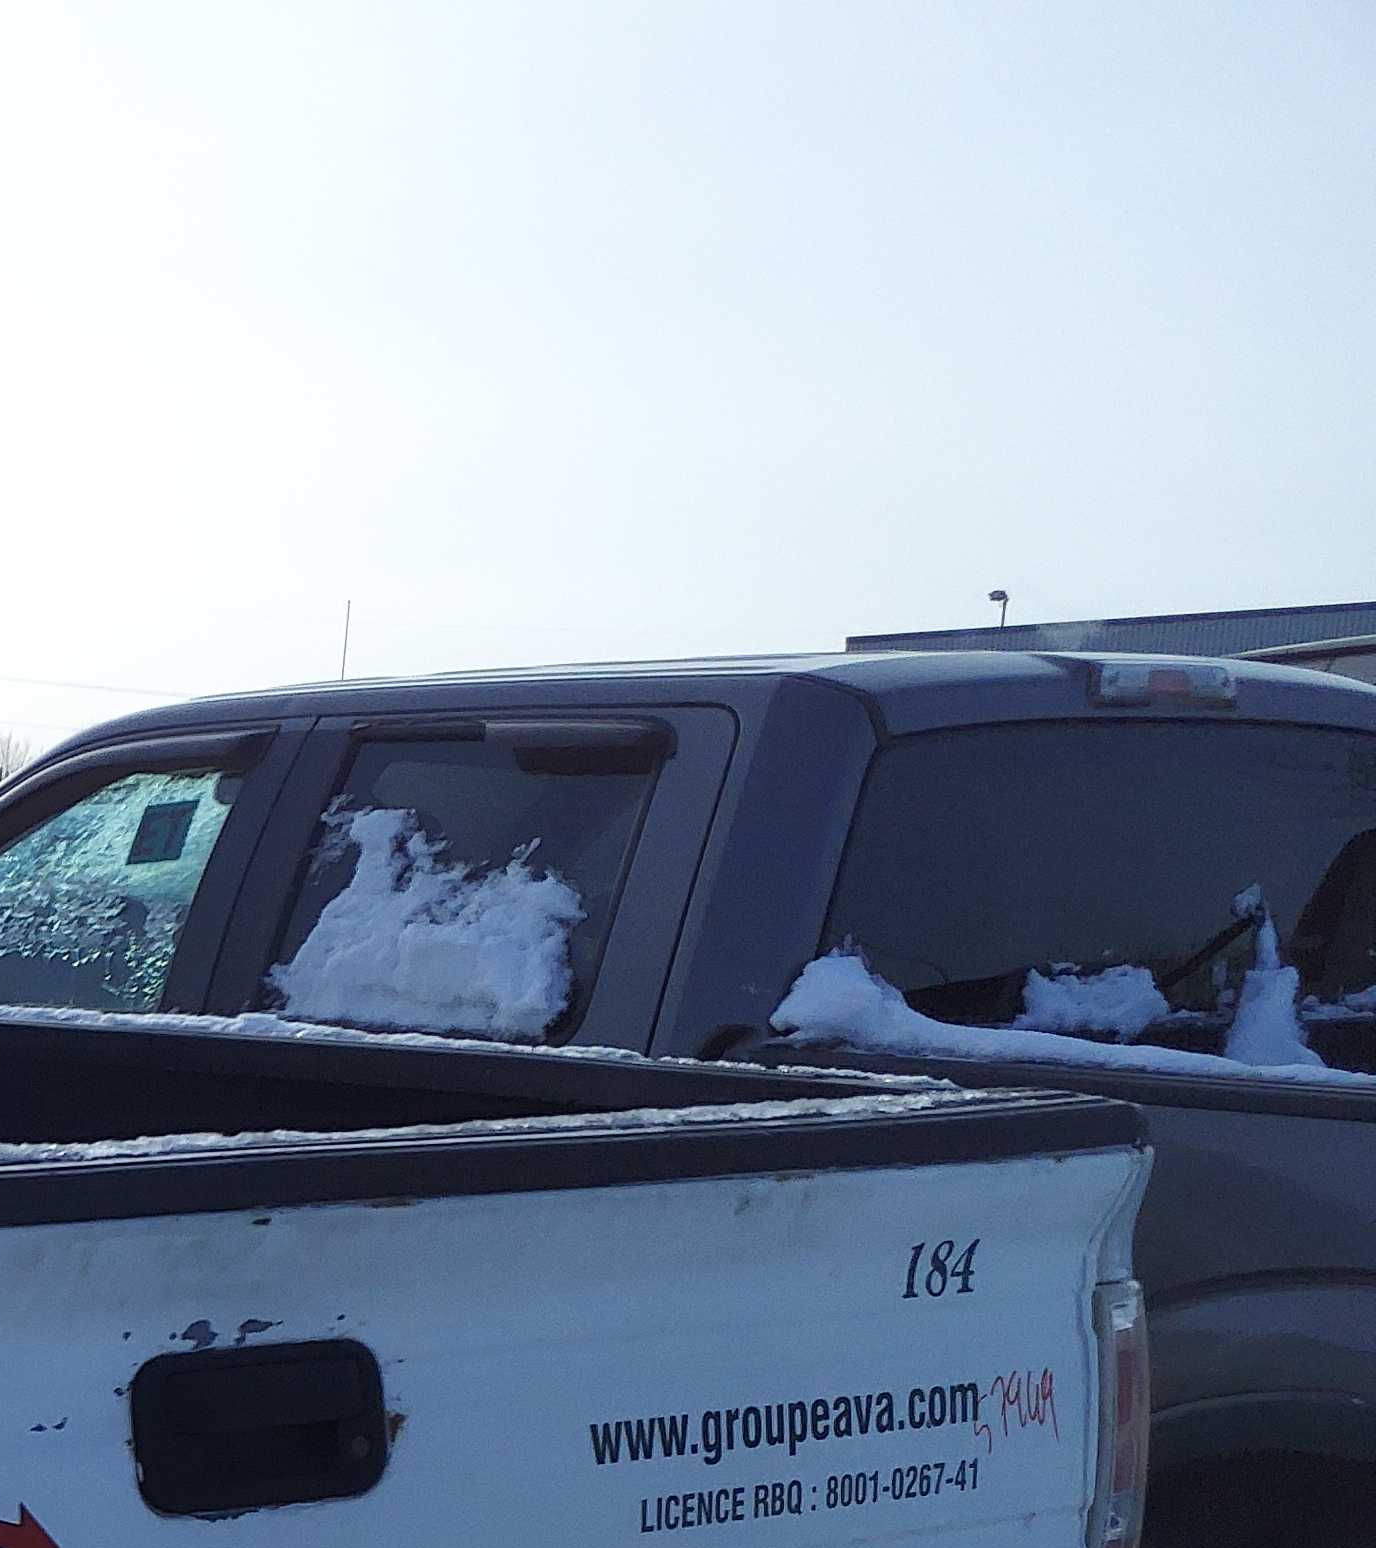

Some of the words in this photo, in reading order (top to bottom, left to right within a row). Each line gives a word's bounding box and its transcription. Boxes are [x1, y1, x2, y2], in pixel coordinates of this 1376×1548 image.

[901, 1238, 980, 1299] 184
[589, 1382, 979, 1465] www.groupeava.com
[640, 1487, 746, 1534] LICENCE
[753, 1480, 803, 1519] RBQ
[826, 1457, 979, 1510] 8001-0267-41
